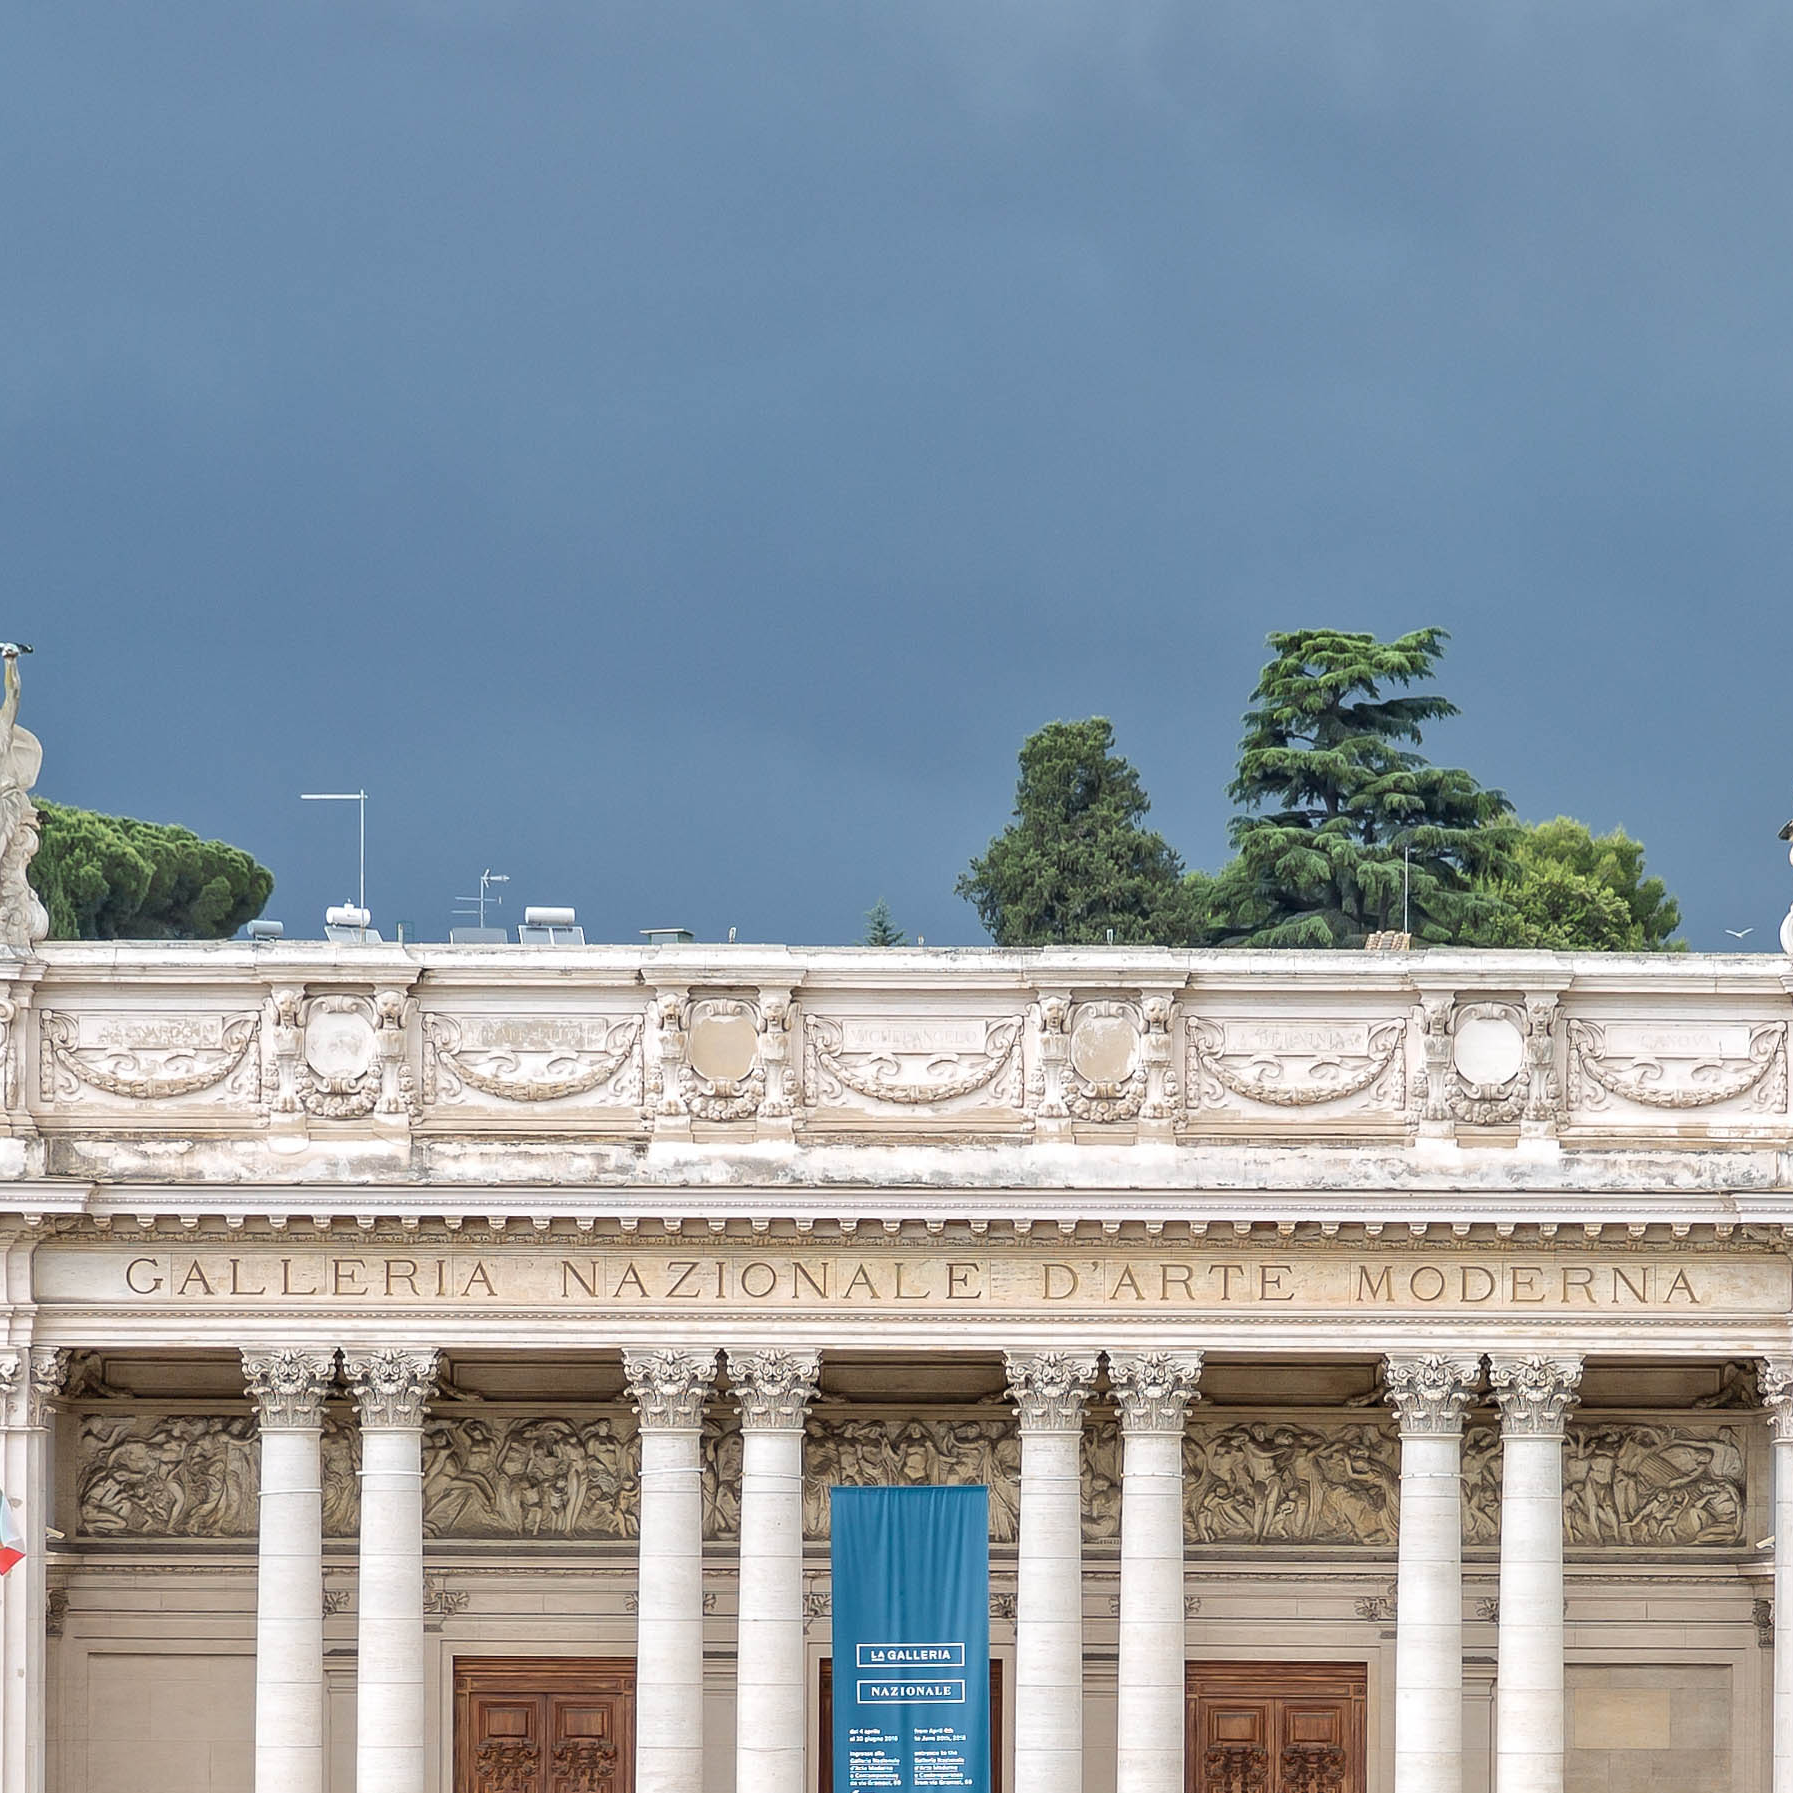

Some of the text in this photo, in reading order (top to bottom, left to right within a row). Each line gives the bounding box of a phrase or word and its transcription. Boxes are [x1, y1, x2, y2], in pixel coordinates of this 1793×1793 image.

[124, 1257, 1702, 1306] GALLERIA NAZIONALE D'ARTE MODERNA
[871, 1649, 952, 1661] LA GALLERIA
[870, 1685, 953, 1697] NAZIONALE
